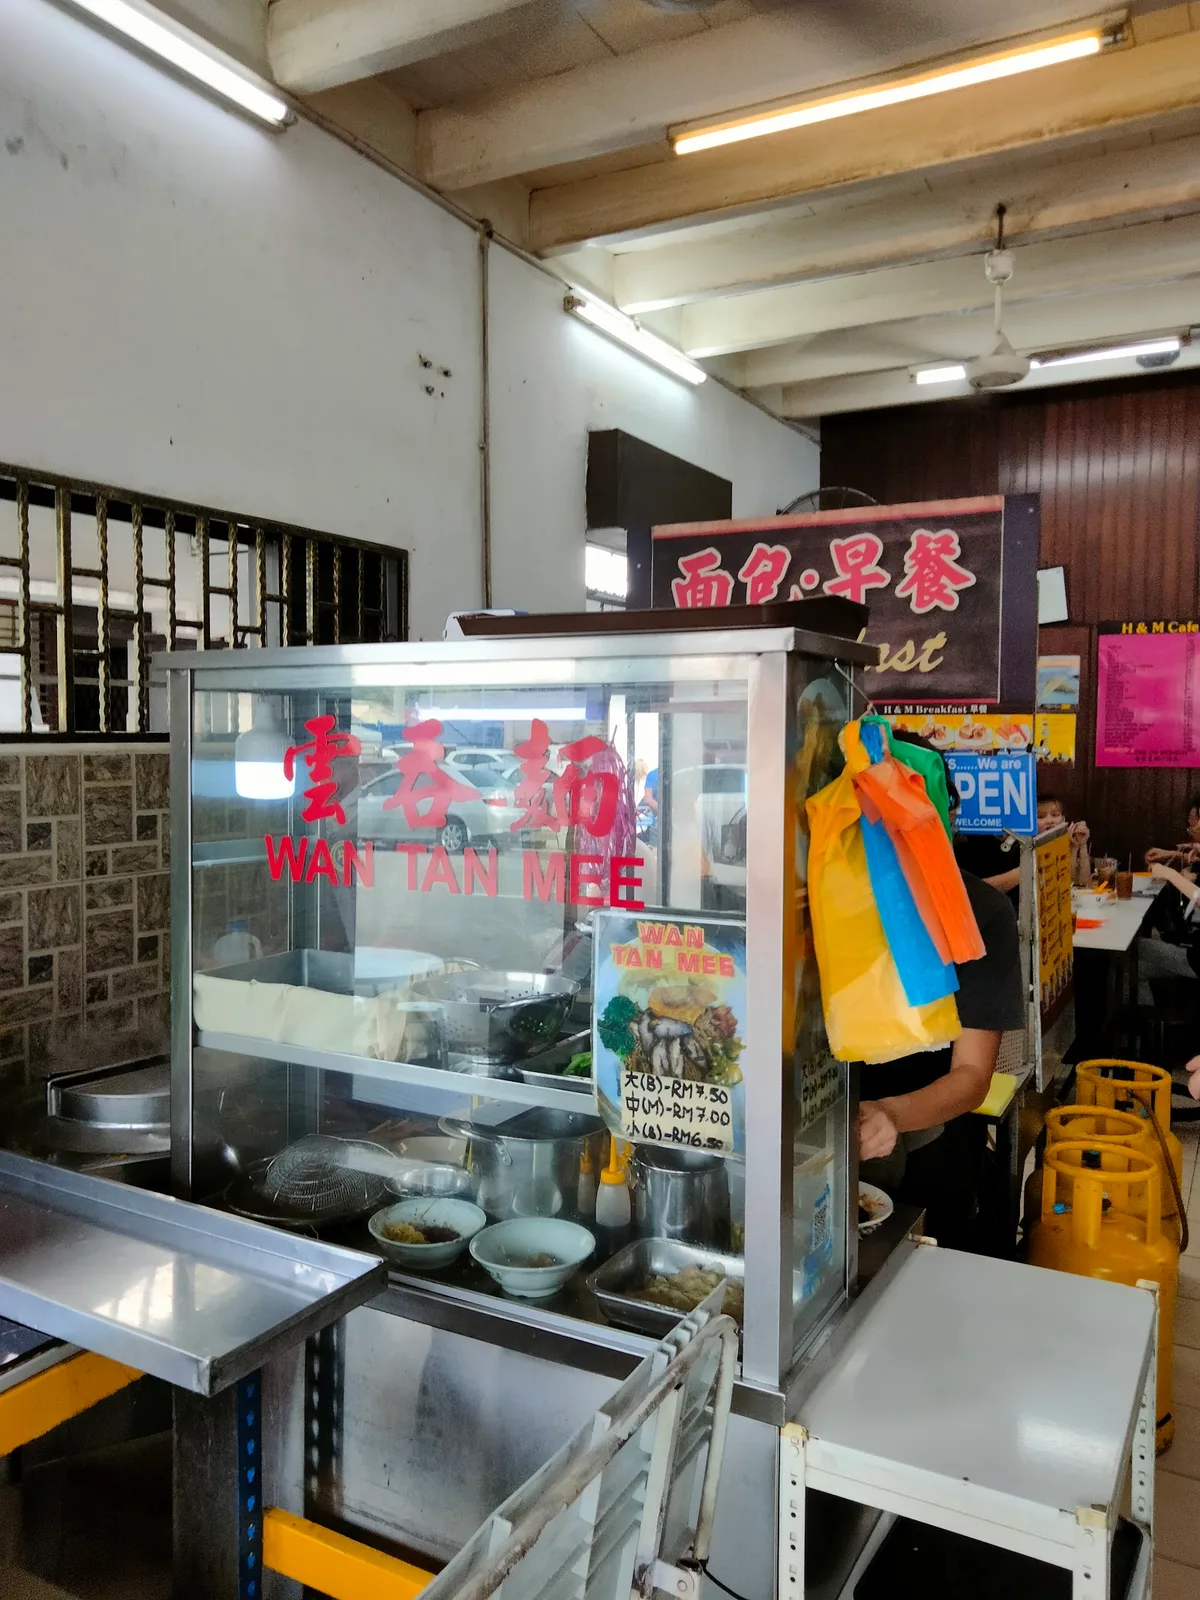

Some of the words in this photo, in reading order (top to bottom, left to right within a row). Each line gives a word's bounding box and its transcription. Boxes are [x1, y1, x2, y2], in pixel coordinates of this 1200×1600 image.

[1121, 622, 1133, 634] H
[1136, 621, 1148, 634] &
[1152, 621, 1165, 633] M
[1167, 620, 1200, 633] Cafe
[883, 705, 892, 714] H
[894, 705, 902, 714] &
[904, 705, 913, 714] M
[916, 704, 968, 714] Breakfast
[283, 714, 619, 837] 雲吞麵
[1001, 759, 1022, 770] are
[950, 771, 1027, 816] PEN
[264, 834, 374, 887] WAN
[396, 842, 499, 897] TAN
[522, 850, 645, 911] MEE
[637, 920, 705, 949] WAN
[611, 943, 663, 970] TAN
[675, 951, 735, 977] MEE
